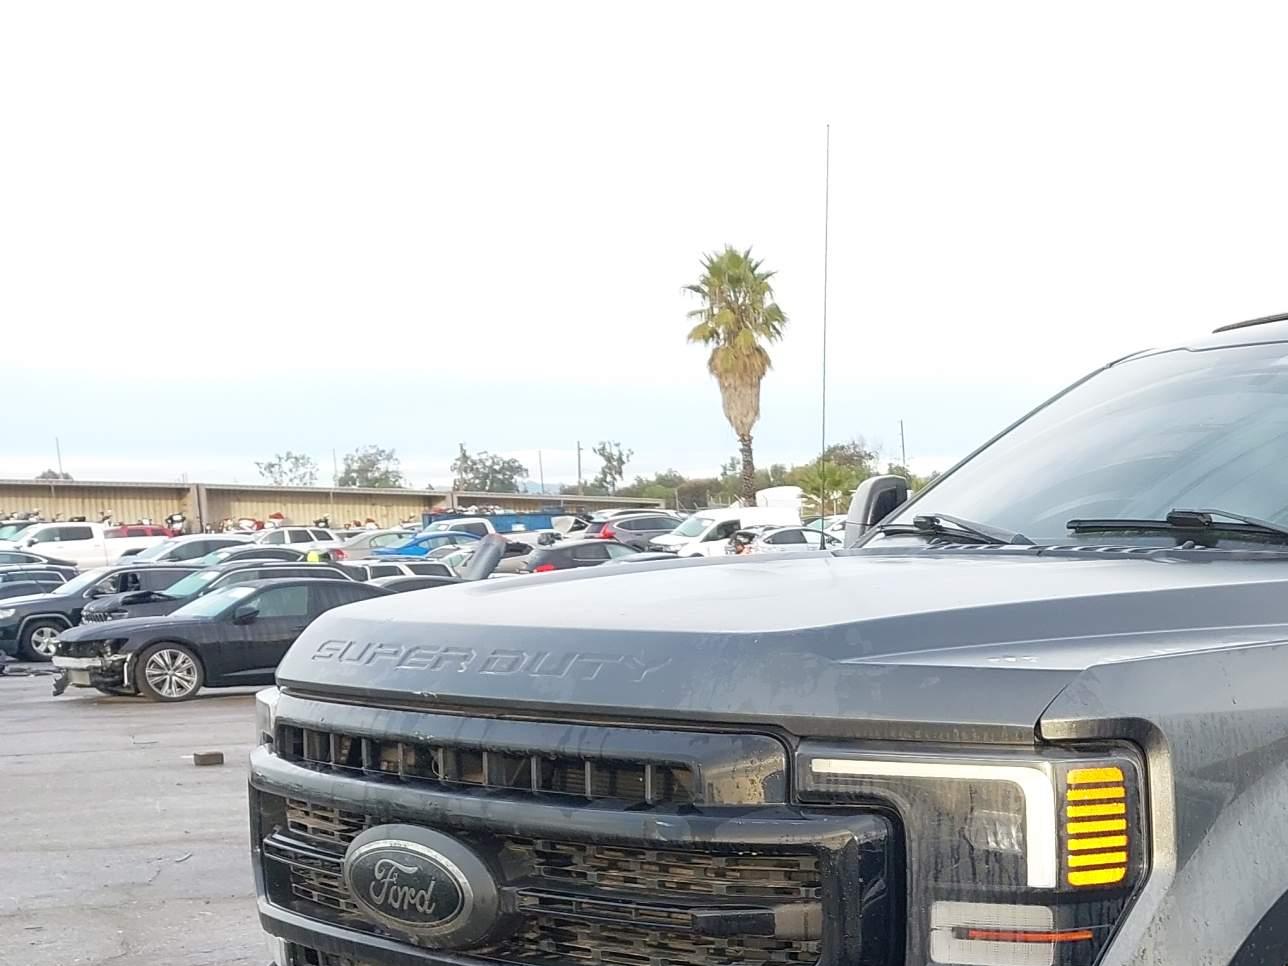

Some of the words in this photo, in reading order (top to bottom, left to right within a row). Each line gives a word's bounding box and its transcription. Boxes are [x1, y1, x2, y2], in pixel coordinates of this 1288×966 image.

[311, 639, 479, 674] SUPER
[479, 648, 673, 684] DUTY
[369, 858, 437, 915] Ford
